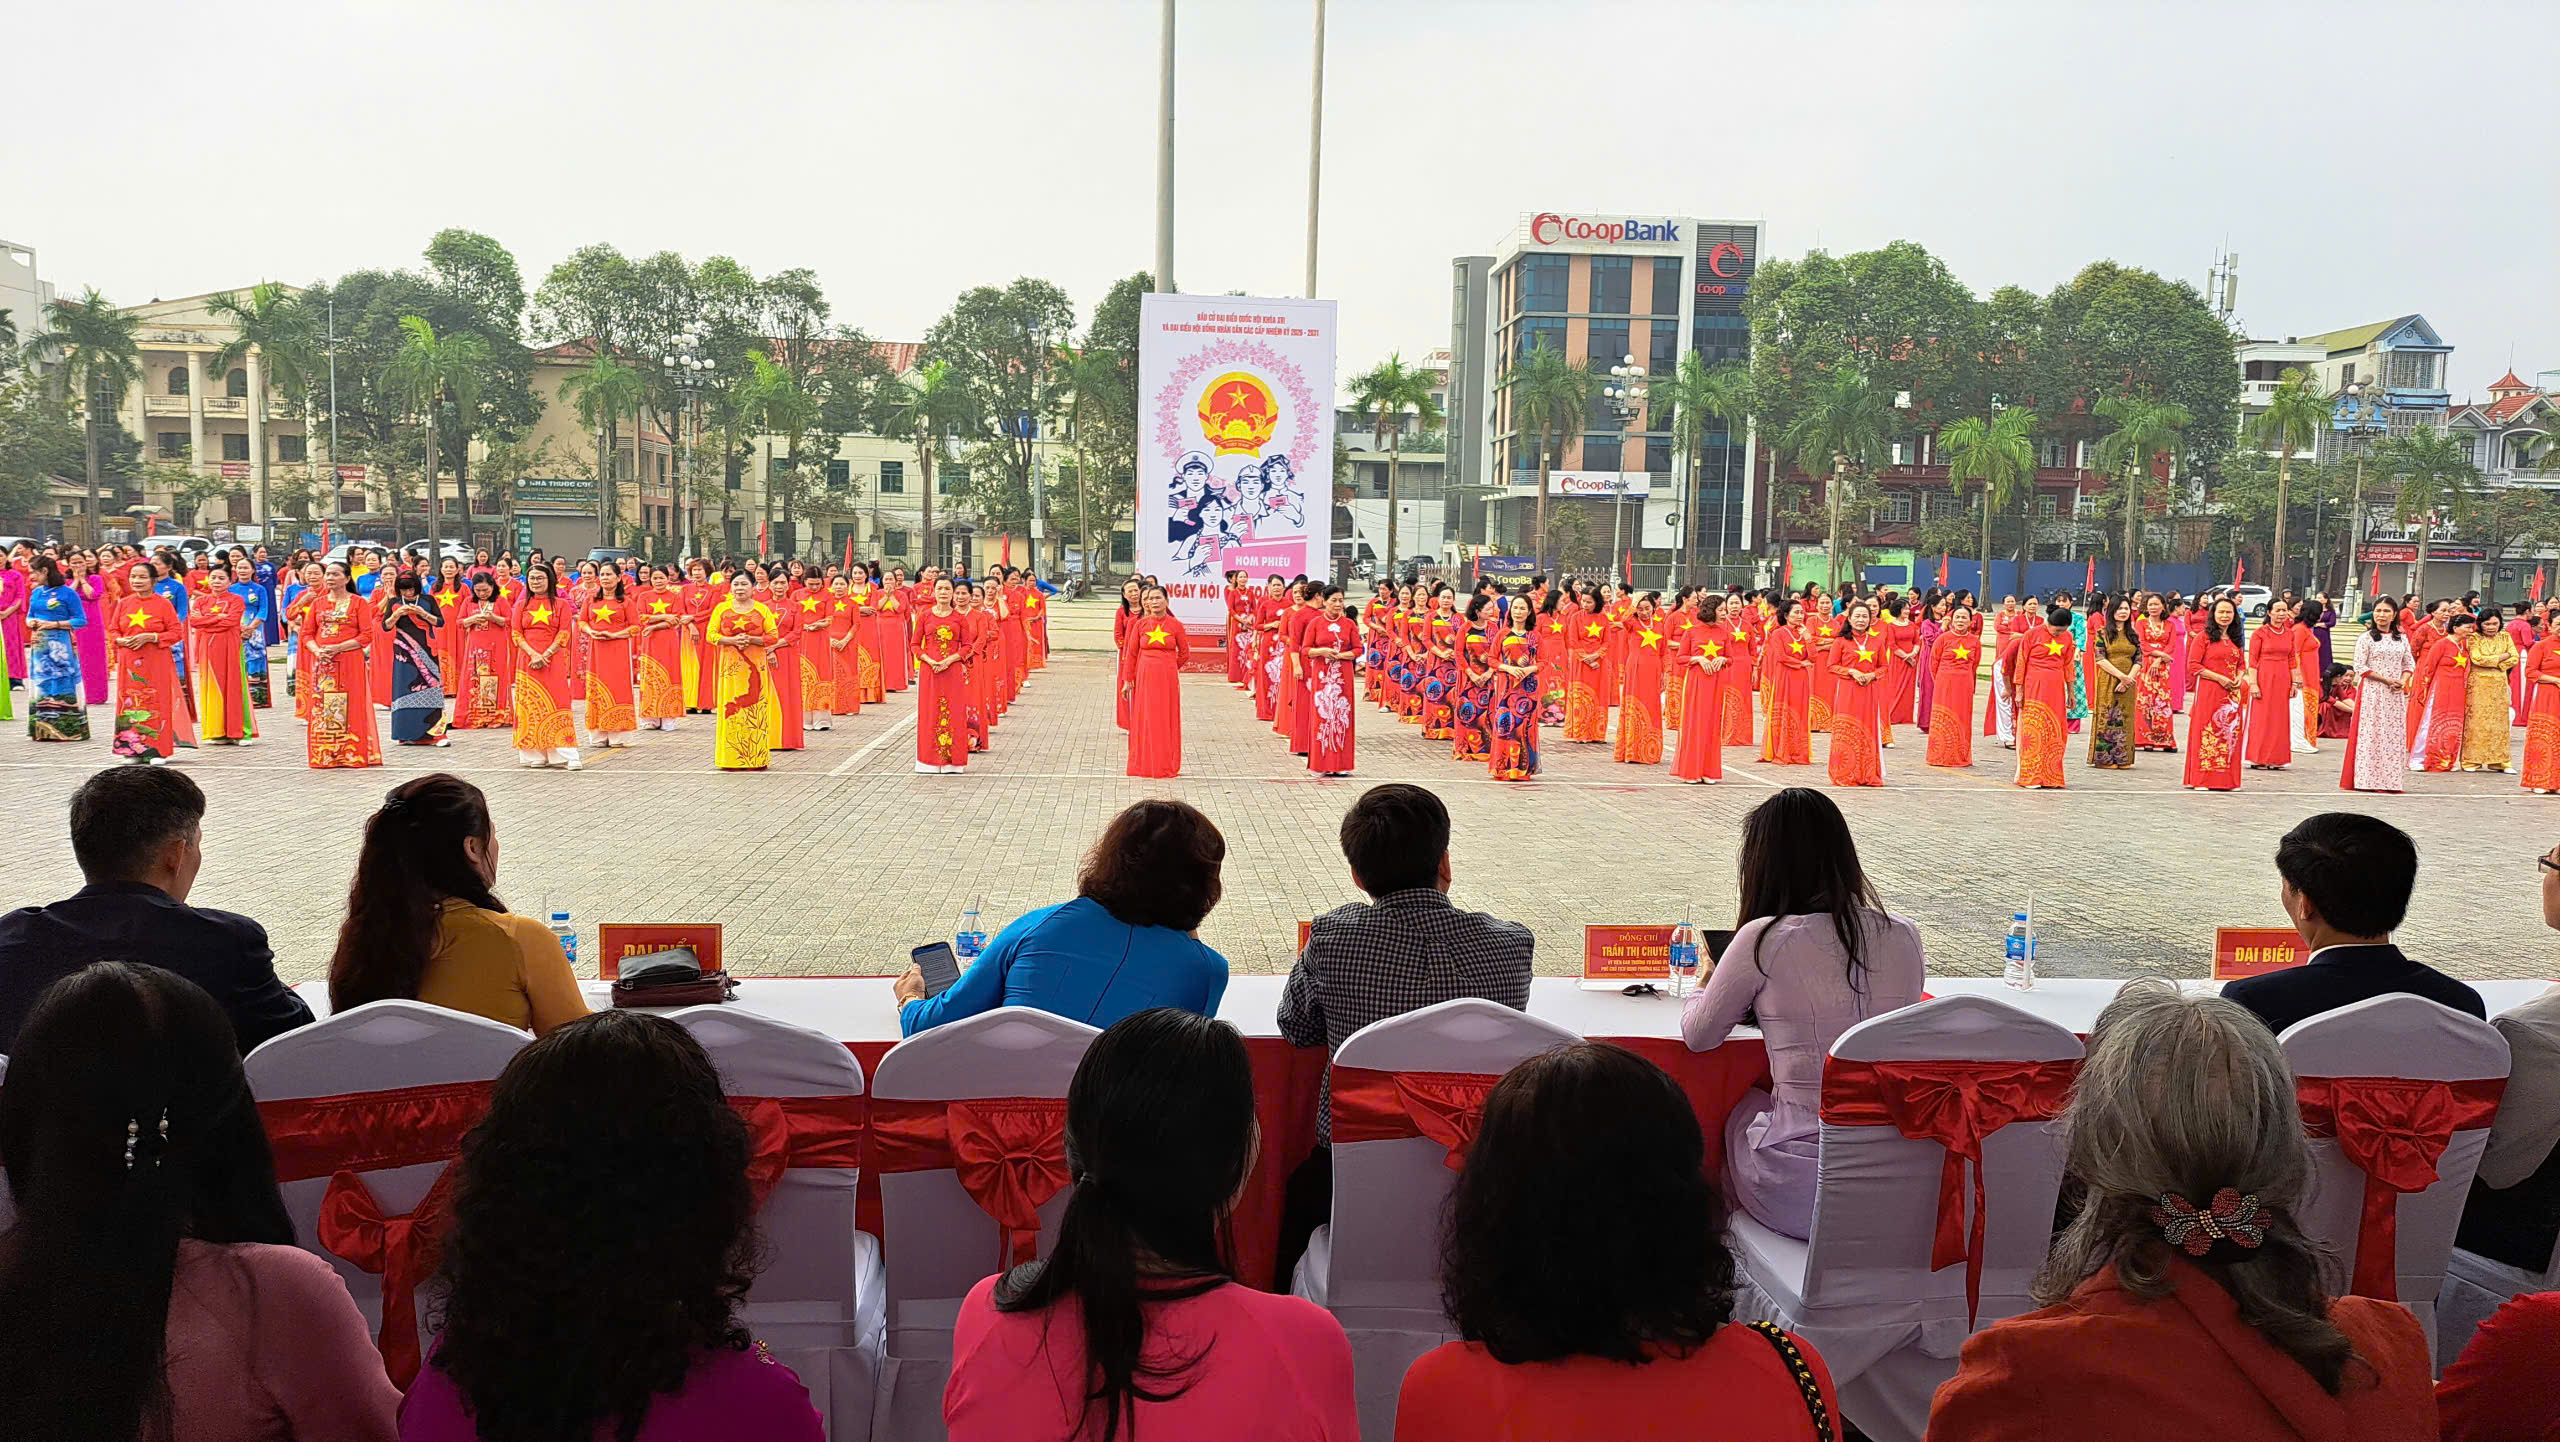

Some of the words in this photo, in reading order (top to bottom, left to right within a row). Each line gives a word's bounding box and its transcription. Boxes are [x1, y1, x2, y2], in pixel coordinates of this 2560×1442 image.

[1565, 217, 1680, 244] Co-opBank
[1200, 581, 1220, 603] HỘI
[1619, 932, 1642, 942] ĐỒNG
[1644, 933, 1658, 942] CHÍ
[1602, 943, 1624, 957] TRẦN
[1627, 946, 1640, 958] THỊ
[1642, 944, 1669, 957] CHUYÊ
[2235, 947, 2259, 966] ĐẠI
[2262, 941, 2295, 963] BIỂU
